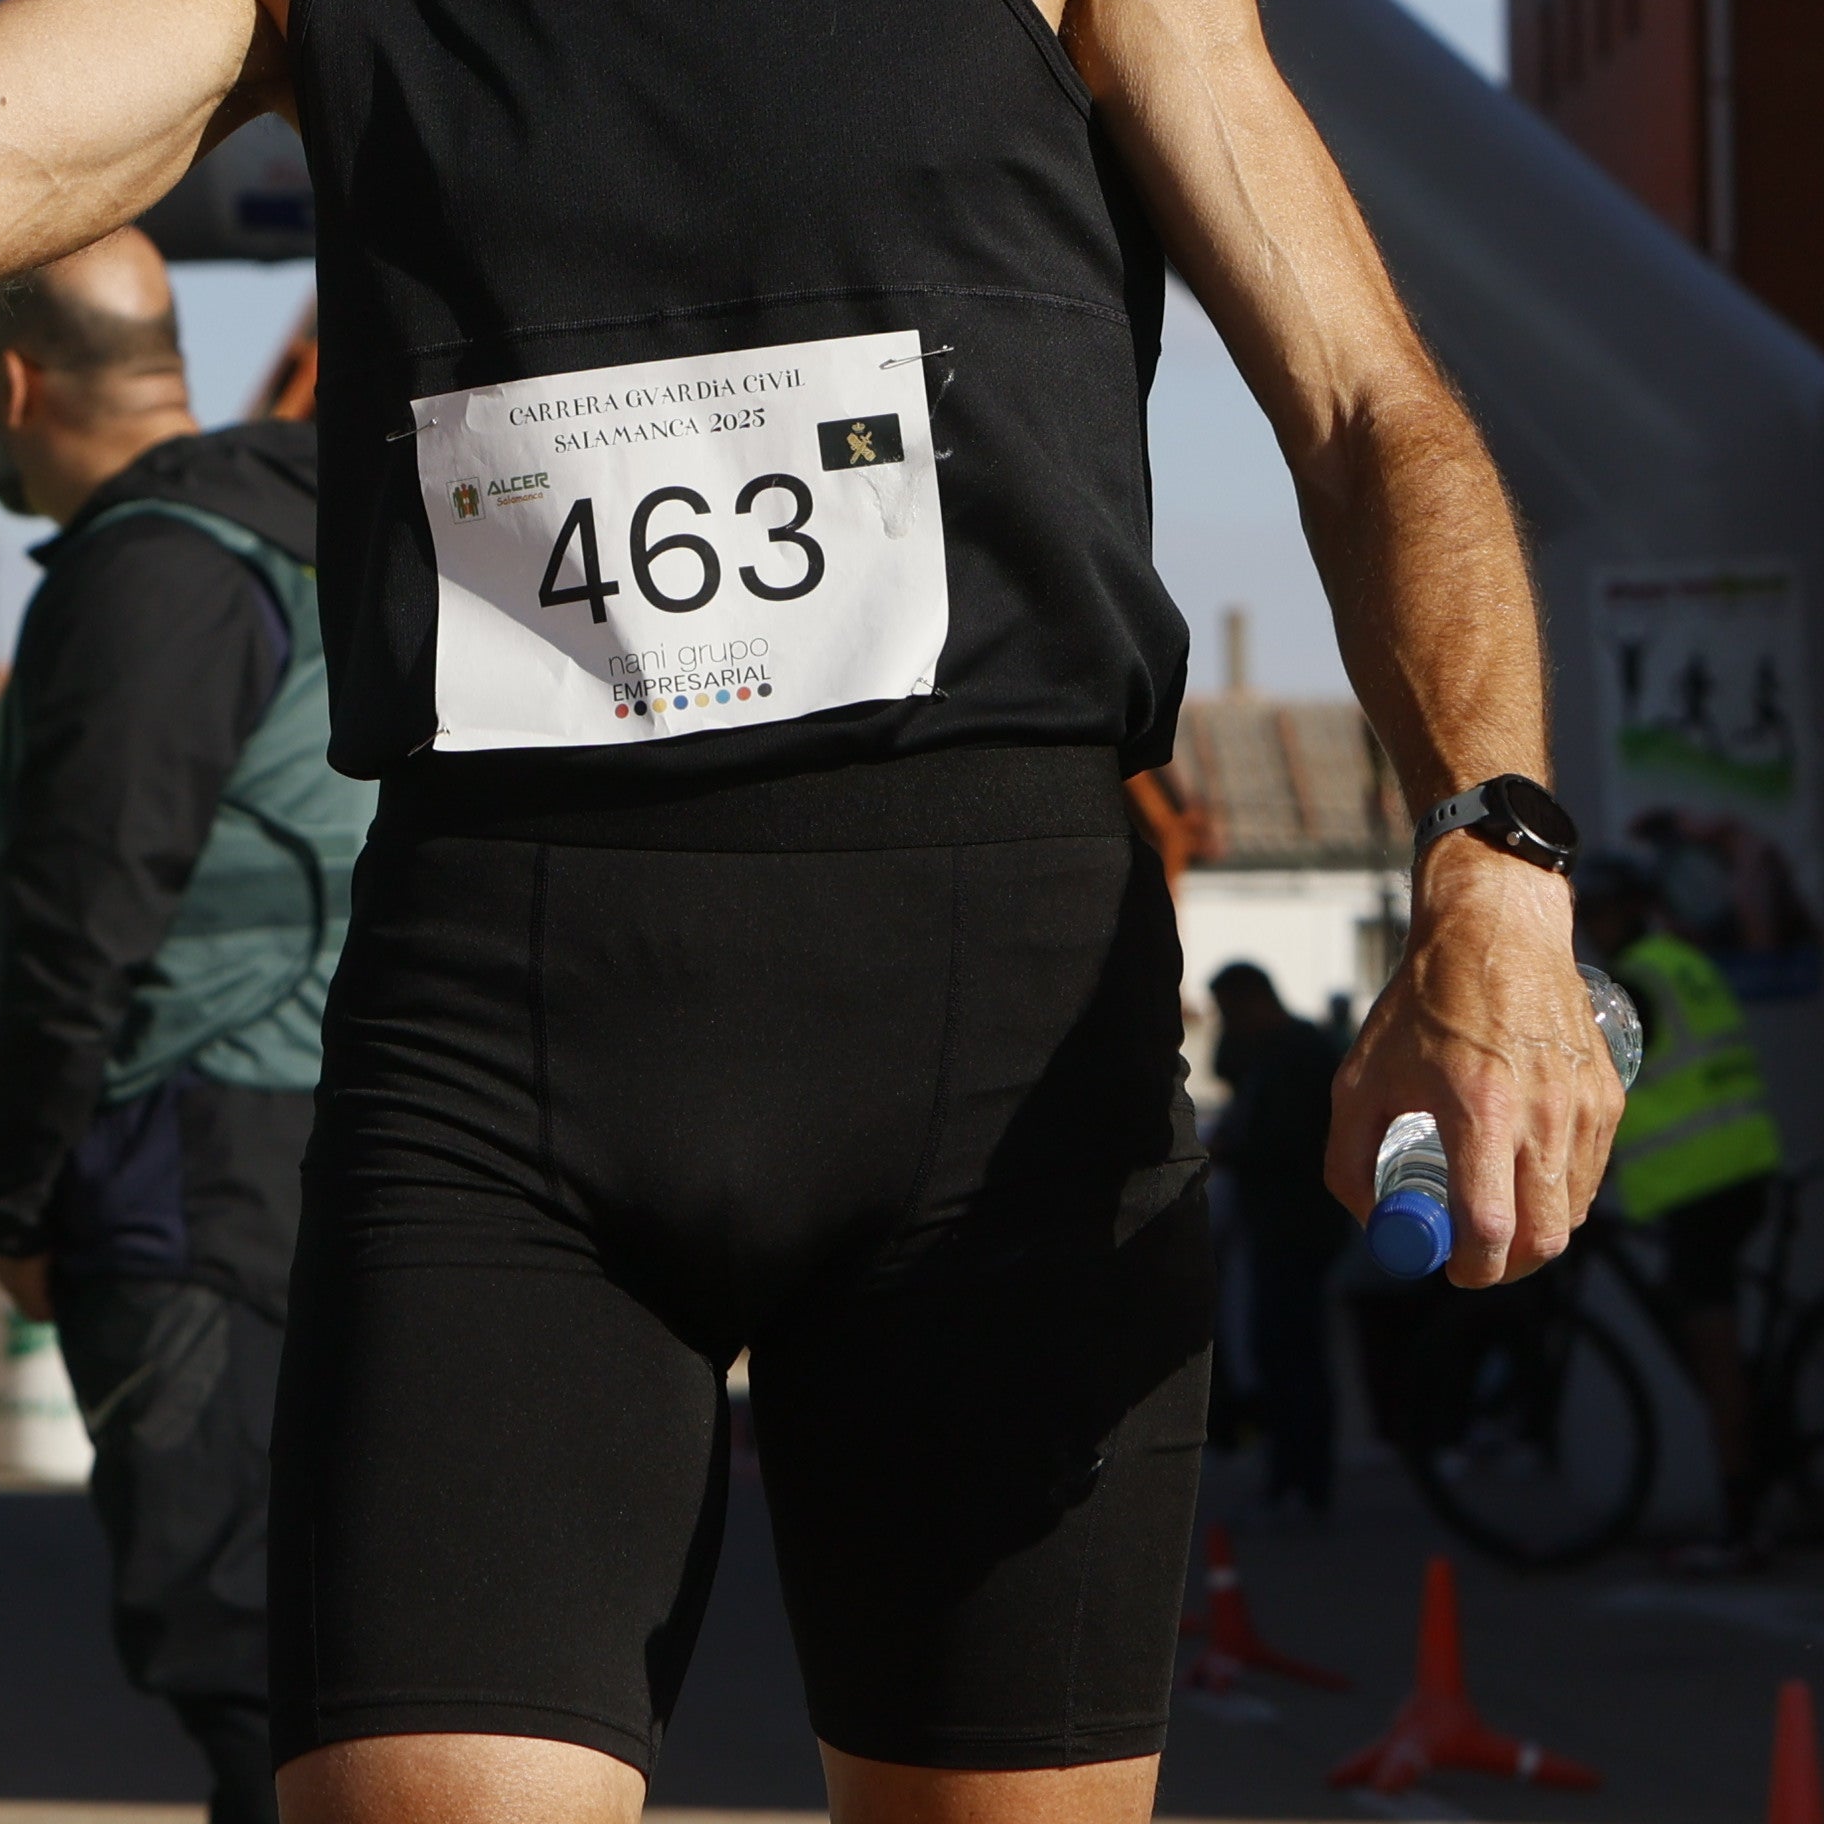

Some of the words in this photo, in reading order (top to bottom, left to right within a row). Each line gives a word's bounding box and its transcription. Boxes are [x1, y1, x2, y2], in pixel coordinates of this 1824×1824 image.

[509, 392, 619, 426] CARRERA
[554, 417, 700, 453] SALAMANCA
[709, 407, 766, 433] 2025
[487, 472, 550, 496] ALCER
[496, 492, 544, 507] Salamanca
[538, 473, 826, 624] 463
[608, 643, 666, 677] nani
[678, 637, 769, 673] grupo
[613, 664, 772, 702] EMPRESARIAL
